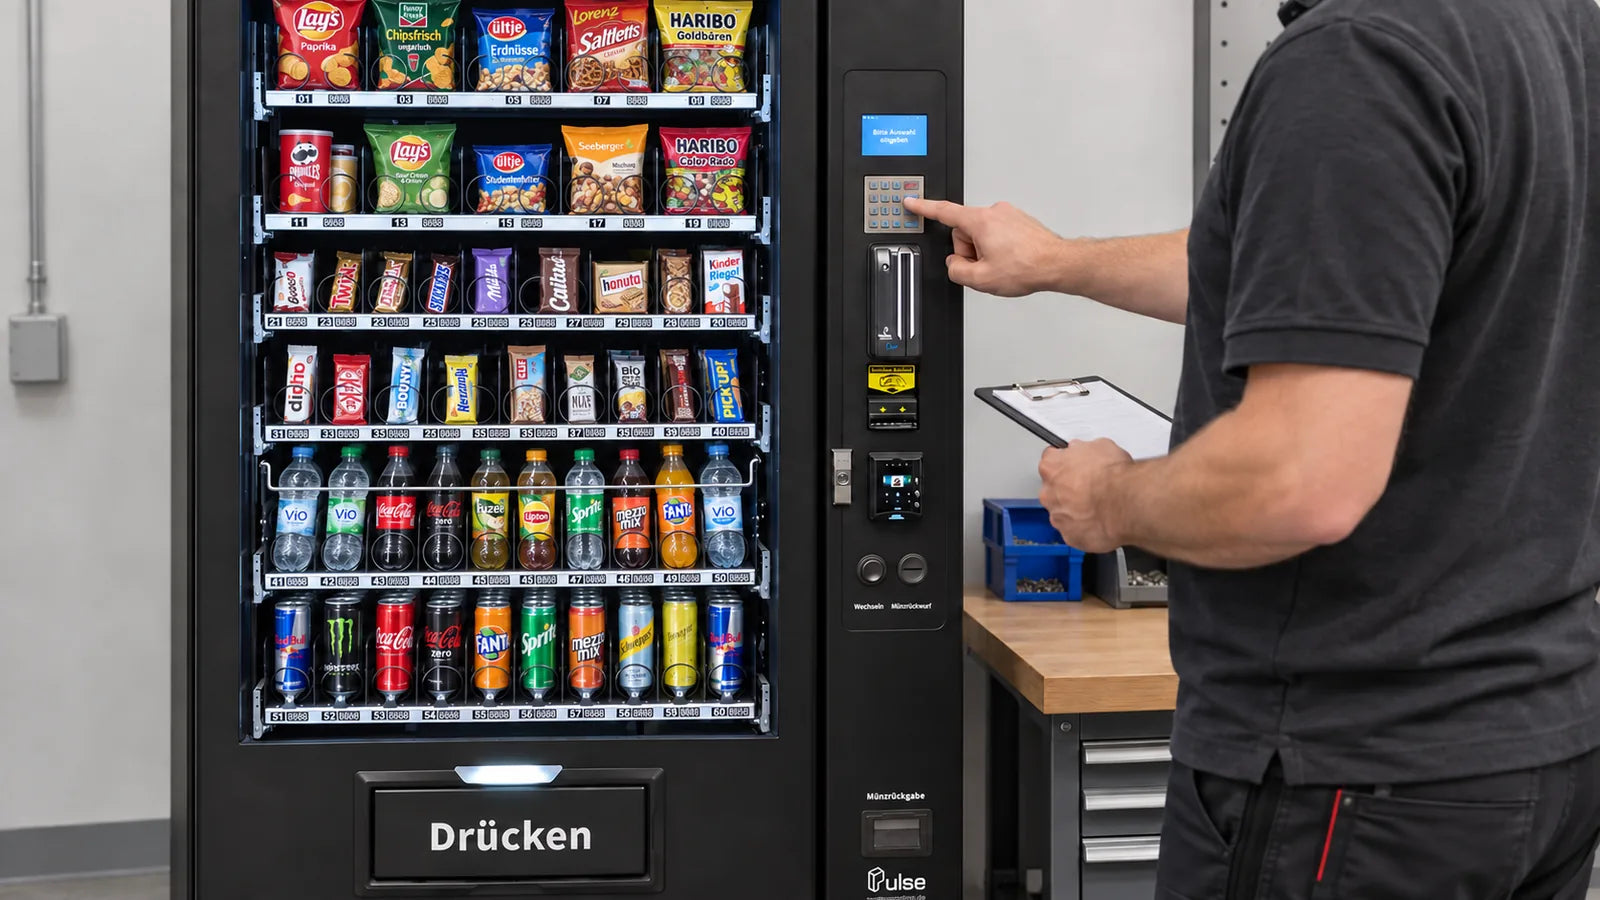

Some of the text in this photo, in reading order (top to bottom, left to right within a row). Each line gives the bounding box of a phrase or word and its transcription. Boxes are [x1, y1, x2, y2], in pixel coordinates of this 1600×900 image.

[573, 6, 620, 26] Lorenz
[671, 13, 736, 29] HARIBO
[492, 19, 523, 38] ültje
[385, 28, 442, 43] Chipsfrisch
[677, 30, 732, 42] Goldbären
[300, 41, 337, 53] Paprika
[490, 44, 539, 56] Erdnüsse
[297, 95, 311, 103] 01
[398, 95, 412, 103] 03
[595, 96, 609, 104] 07
[578, 141, 624, 153] Seeberger
[676, 139, 738, 155] HARIBO
[496, 155, 521, 170] ültje
[293, 218, 306, 226] 11
[393, 218, 407, 227] 13
[500, 219, 513, 227] 15
[590, 219, 604, 228] 17
[686, 219, 700, 228] 19
[708, 257, 740, 270] Kinder
[602, 272, 641, 292] hanuta
[269, 318, 281, 326] 21
[319, 318, 332, 326] 23
[372, 318, 385, 326] 23
[424, 318, 436, 326] 25
[568, 318, 580, 327] 27
[617, 319, 629, 327] 29
[712, 318, 724, 327] 20
[722, 387, 737, 419] PICK
[272, 430, 284, 438] 31
[322, 430, 334, 438] 33
[373, 430, 385, 438] 35
[521, 429, 533, 437] 35
[569, 429, 582, 437] 37
[713, 428, 726, 436] 40
[571, 498, 603, 524] Sprite
[525, 512, 549, 523] Lipton
[620, 517, 642, 531] mix
[272, 578, 284, 586] 41
[322, 577, 334, 586] 42
[372, 577, 385, 585] 43
[424, 577, 436, 585] 44
[474, 576, 486, 584] 45
[521, 576, 533, 584] 45
[570, 576, 582, 584] 47
[665, 574, 677, 582] 49
[713, 574, 726, 582] 50
[853, 602, 885, 610] Wechseln
[891, 602, 932, 610] Münzrückwurf
[431, 649, 452, 658] zero
[577, 647, 600, 663] mix
[323, 712, 335, 720] 52
[372, 712, 385, 720] 53
[424, 712, 436, 720] 54
[474, 710, 486, 719] 55
[520, 710, 533, 718] 56
[569, 710, 581, 718] 57
[618, 709, 630, 717] 56
[713, 708, 726, 716] 60
[272, 712, 284, 721] 51
[866, 792, 926, 802] Münzrückgabe
[431, 819, 592, 851] Drücken
[867, 866, 927, 892] Pulse
